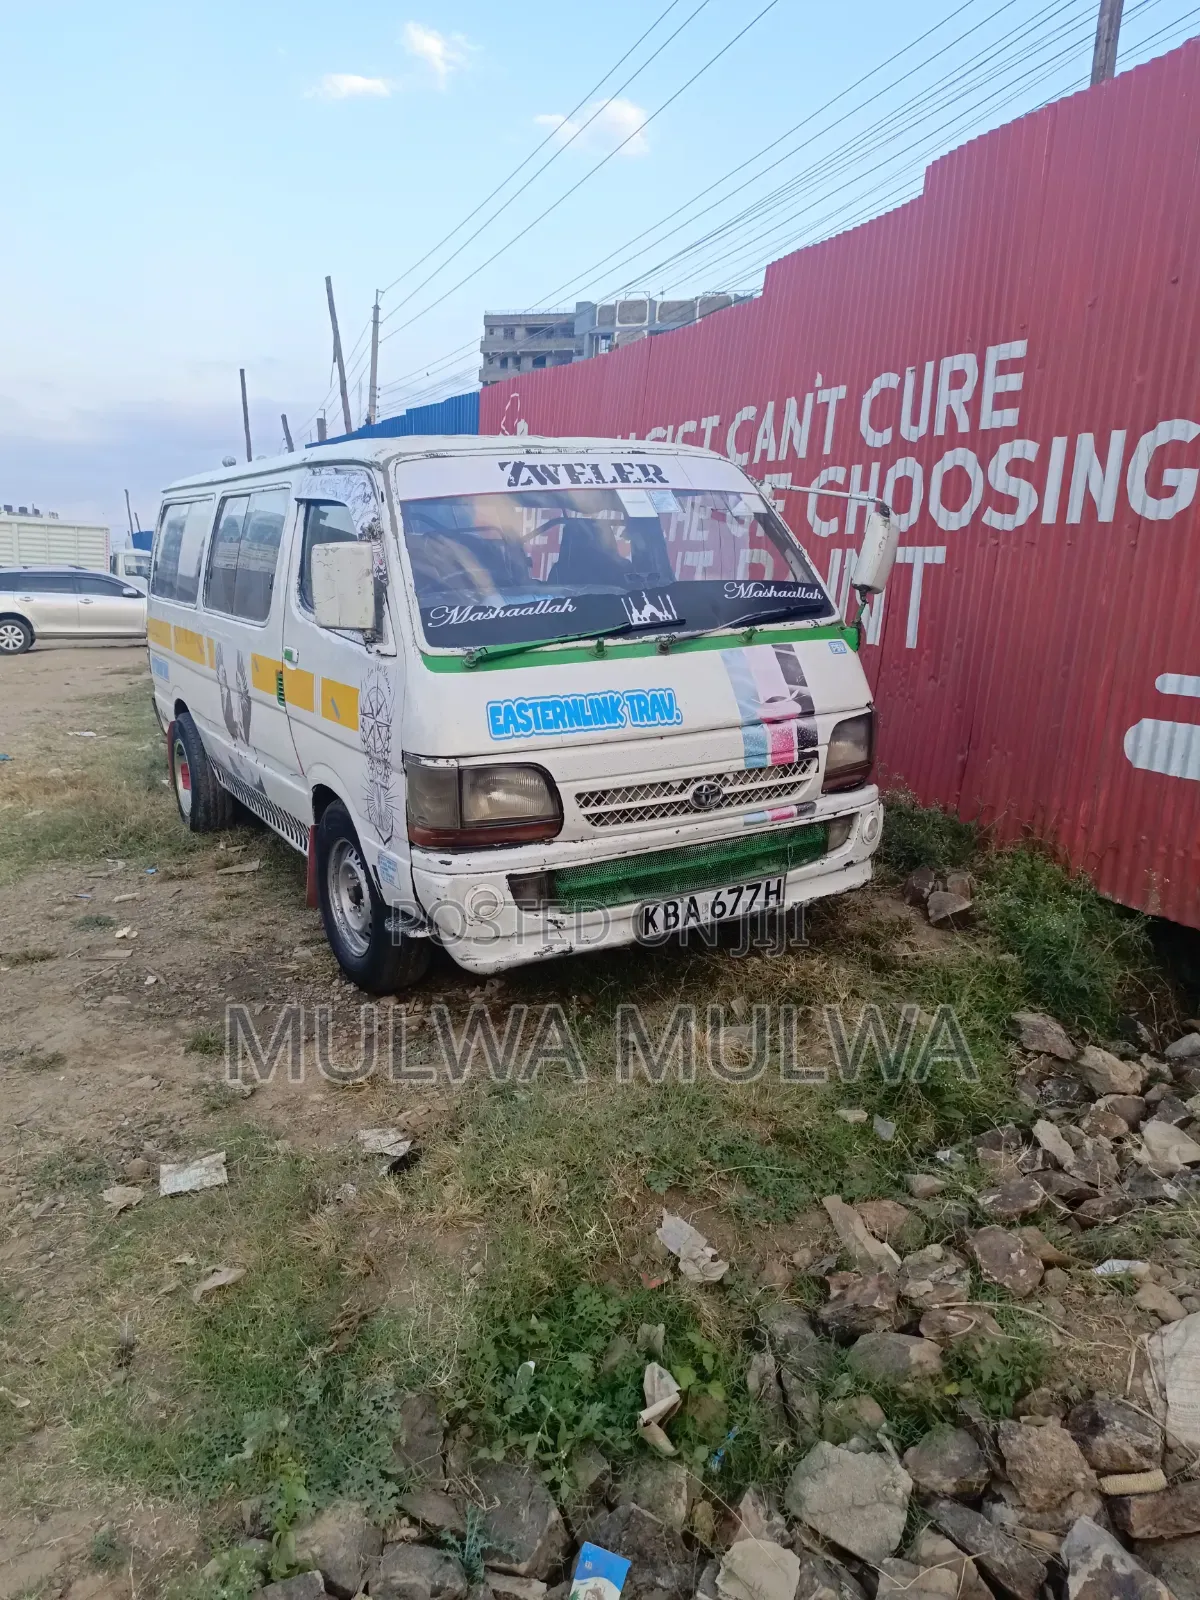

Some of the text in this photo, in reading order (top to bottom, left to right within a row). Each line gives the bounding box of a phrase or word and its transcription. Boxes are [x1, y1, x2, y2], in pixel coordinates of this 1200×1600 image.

[727, 338, 1028, 467] CAN'T CURE
[807, 418, 1200, 538] CHOOSING
[427, 598, 577, 628] Mashaallah
[724, 581, 824, 600] Mashaallah
[487, 688, 682, 739] EASTERNLINK TRAV.
[644, 878, 782, 936] KBA 677H
